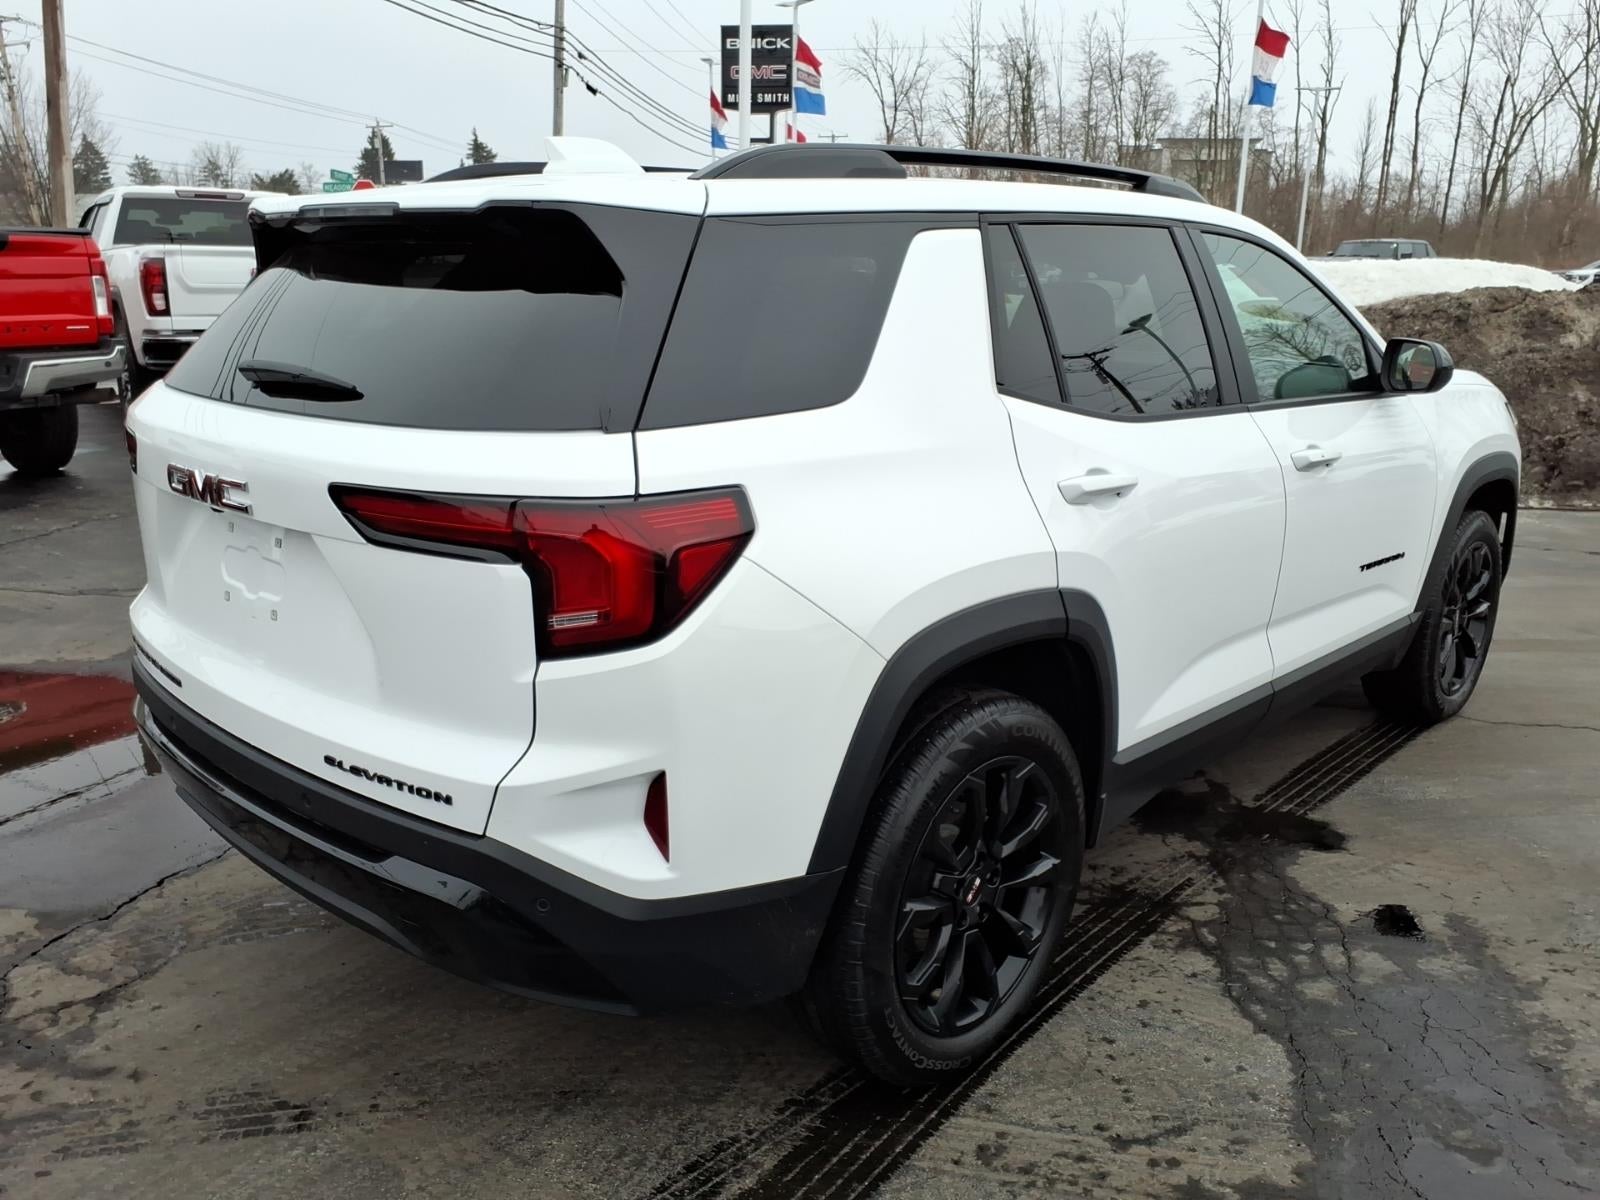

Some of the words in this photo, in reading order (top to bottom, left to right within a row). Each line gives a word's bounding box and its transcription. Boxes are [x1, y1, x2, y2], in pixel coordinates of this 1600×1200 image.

[757, 93, 790, 103] SMITH
[167, 463, 253, 516] GMC
[323, 754, 453, 806] ELEVATION
